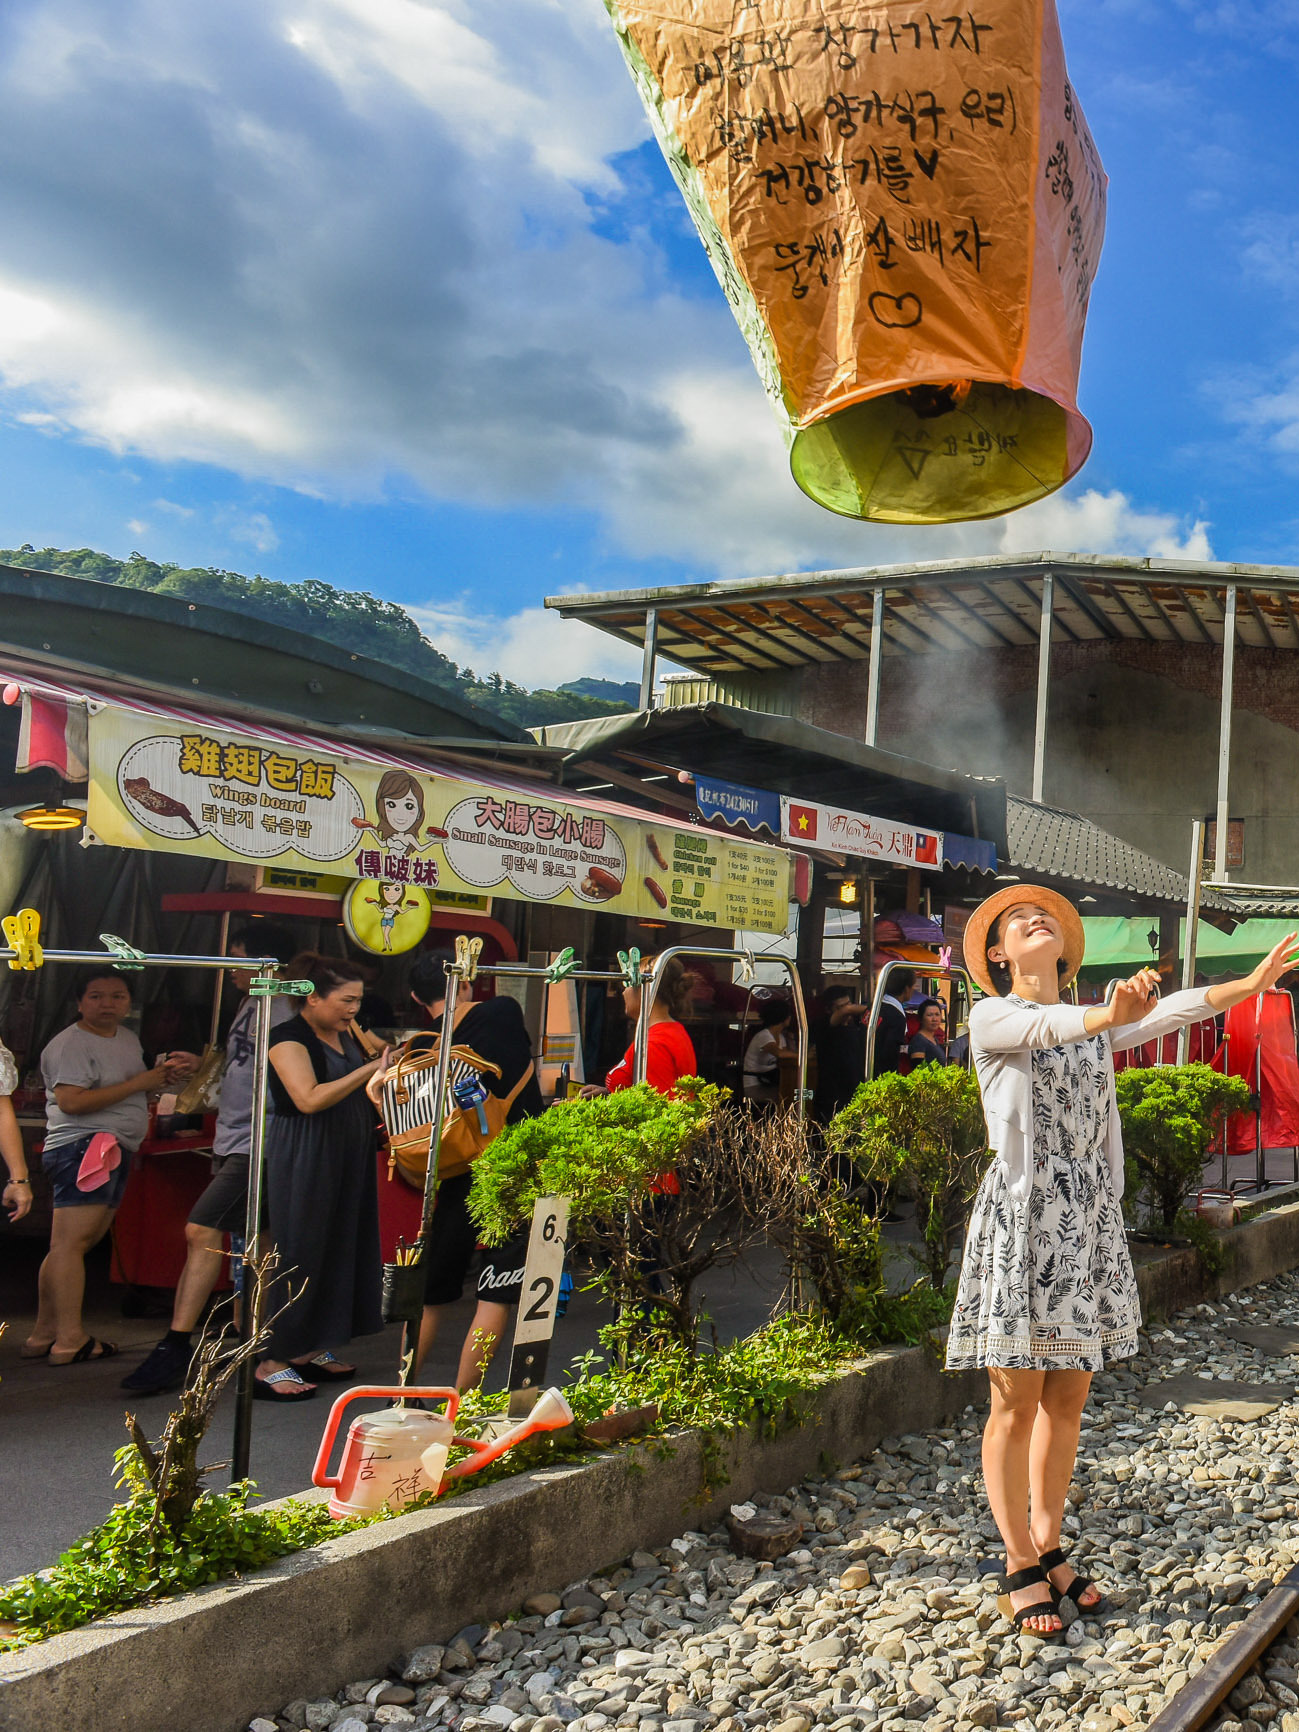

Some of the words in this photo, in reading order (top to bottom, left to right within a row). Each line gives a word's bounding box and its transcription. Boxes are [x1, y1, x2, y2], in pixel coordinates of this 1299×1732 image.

[179, 734, 336, 800] 雞翅包飯
[208, 783, 257, 806] Wings
[260, 793, 307, 814] board
[201, 803, 254, 829] 닭날개
[261, 814, 312, 838] 볶음밥
[474, 796, 606, 850] 大腸包小腸
[451, 827, 486, 845] Small
[488, 834, 535, 854] Sausage
[536, 842, 548, 856] in
[549, 845, 579, 861] Large
[579, 851, 621, 869] Sausage
[886, 830, 914, 858] 天鼎
[501, 854, 538, 874] 대만식
[542, 861, 577, 879] 핫도그
[478, 1264, 526, 1292] Craz
[523, 1276, 554, 1322] 2
